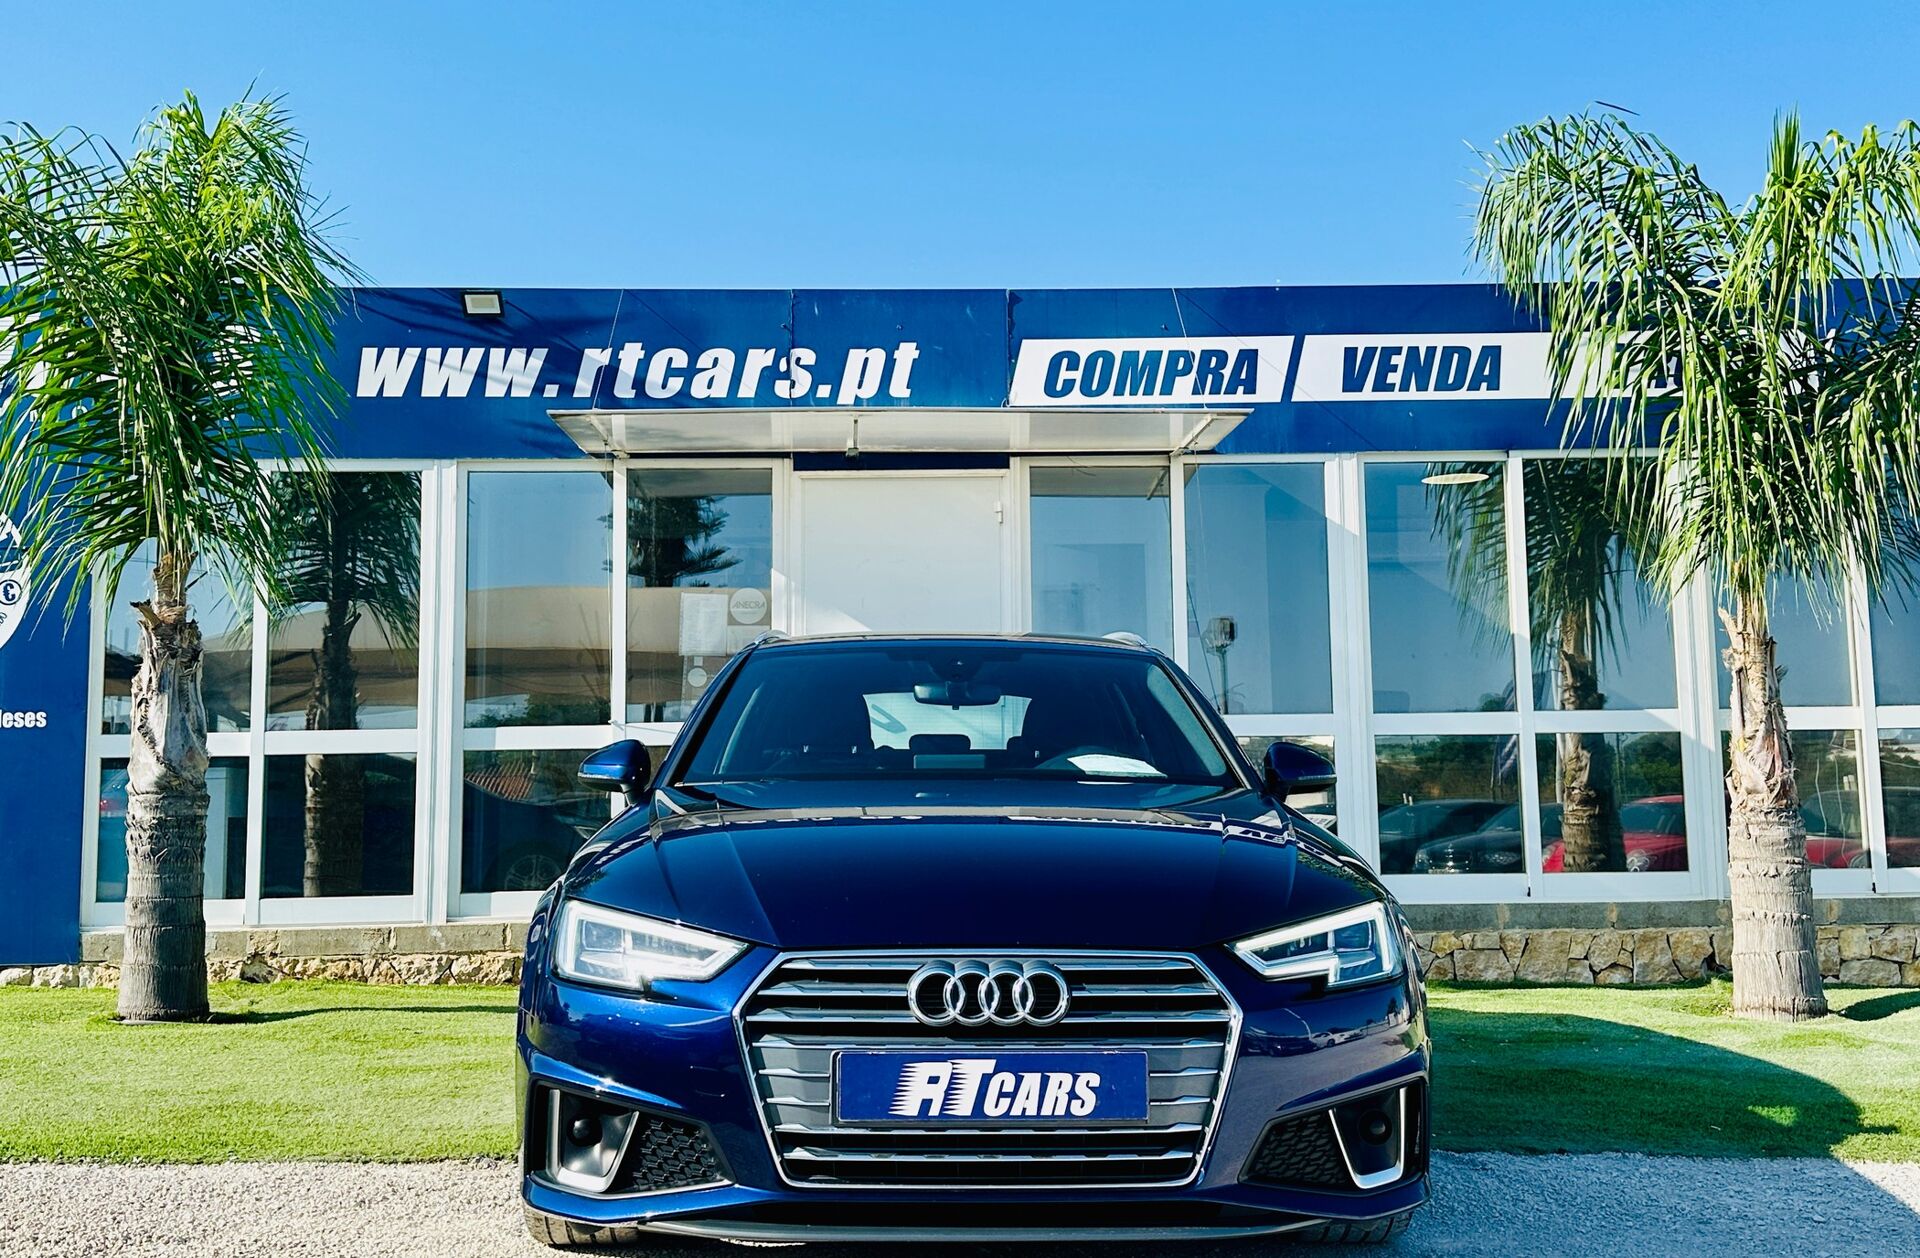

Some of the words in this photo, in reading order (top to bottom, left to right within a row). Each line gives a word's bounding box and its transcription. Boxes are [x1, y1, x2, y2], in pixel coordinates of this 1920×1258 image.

[356, 342, 920, 405] www.rtcars.pt
[1044, 349, 1259, 398] COMPRA
[1342, 345, 1502, 392] VENDA
